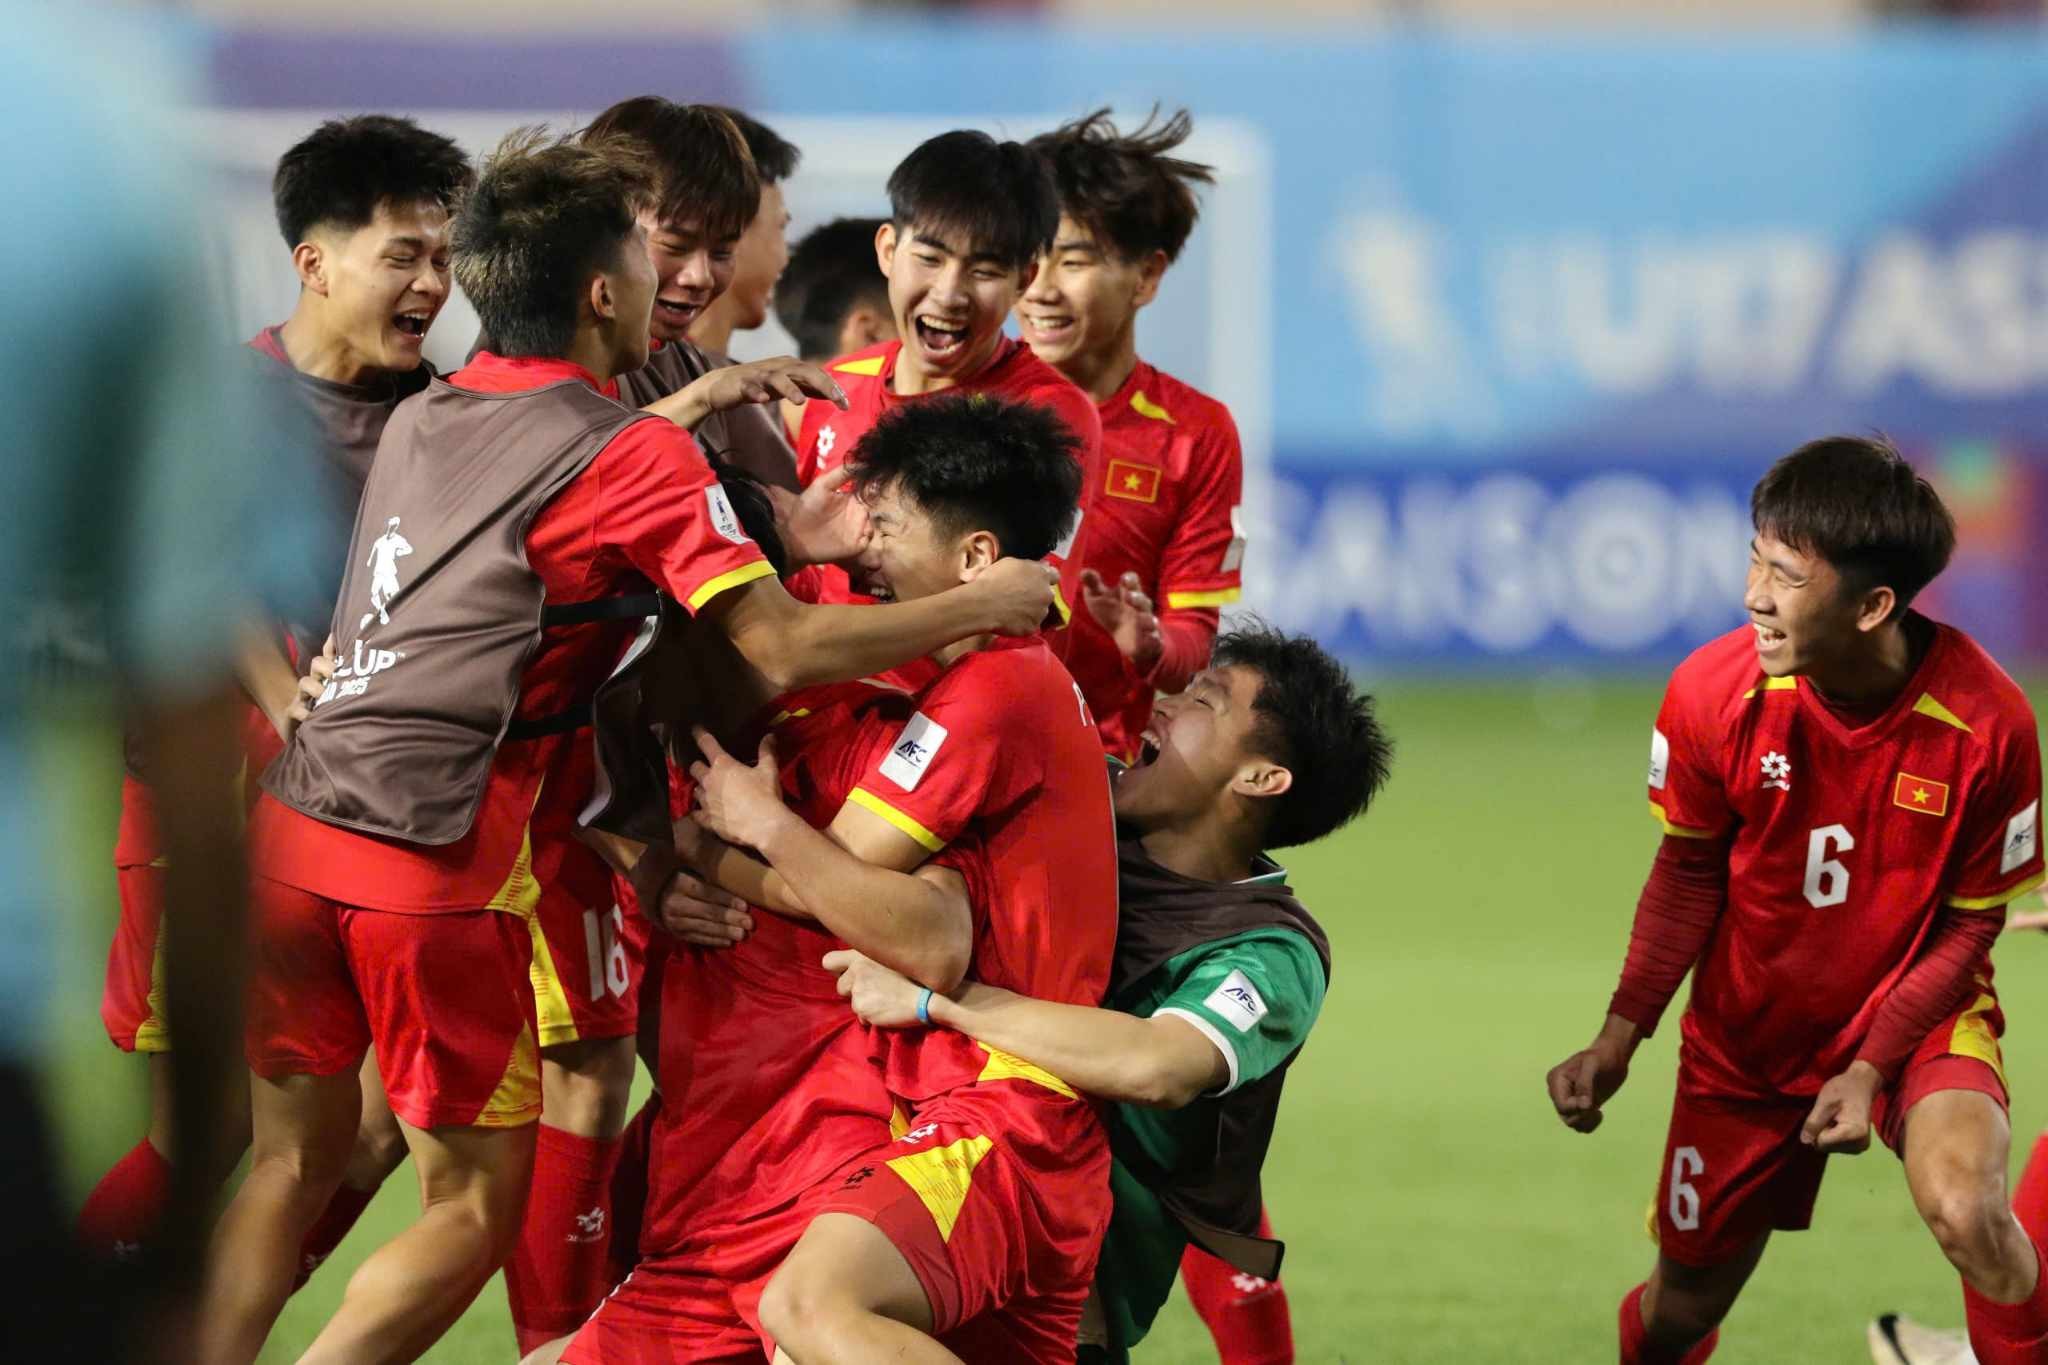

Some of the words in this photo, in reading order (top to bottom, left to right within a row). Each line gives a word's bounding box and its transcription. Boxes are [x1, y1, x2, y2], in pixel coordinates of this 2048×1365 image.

[898, 739, 928, 763] AFC
[1803, 823, 1855, 909] 6
[582, 903, 630, 1003] 16
[1223, 987, 1257, 1012] AFC
[1668, 1146, 1705, 1232] 6
